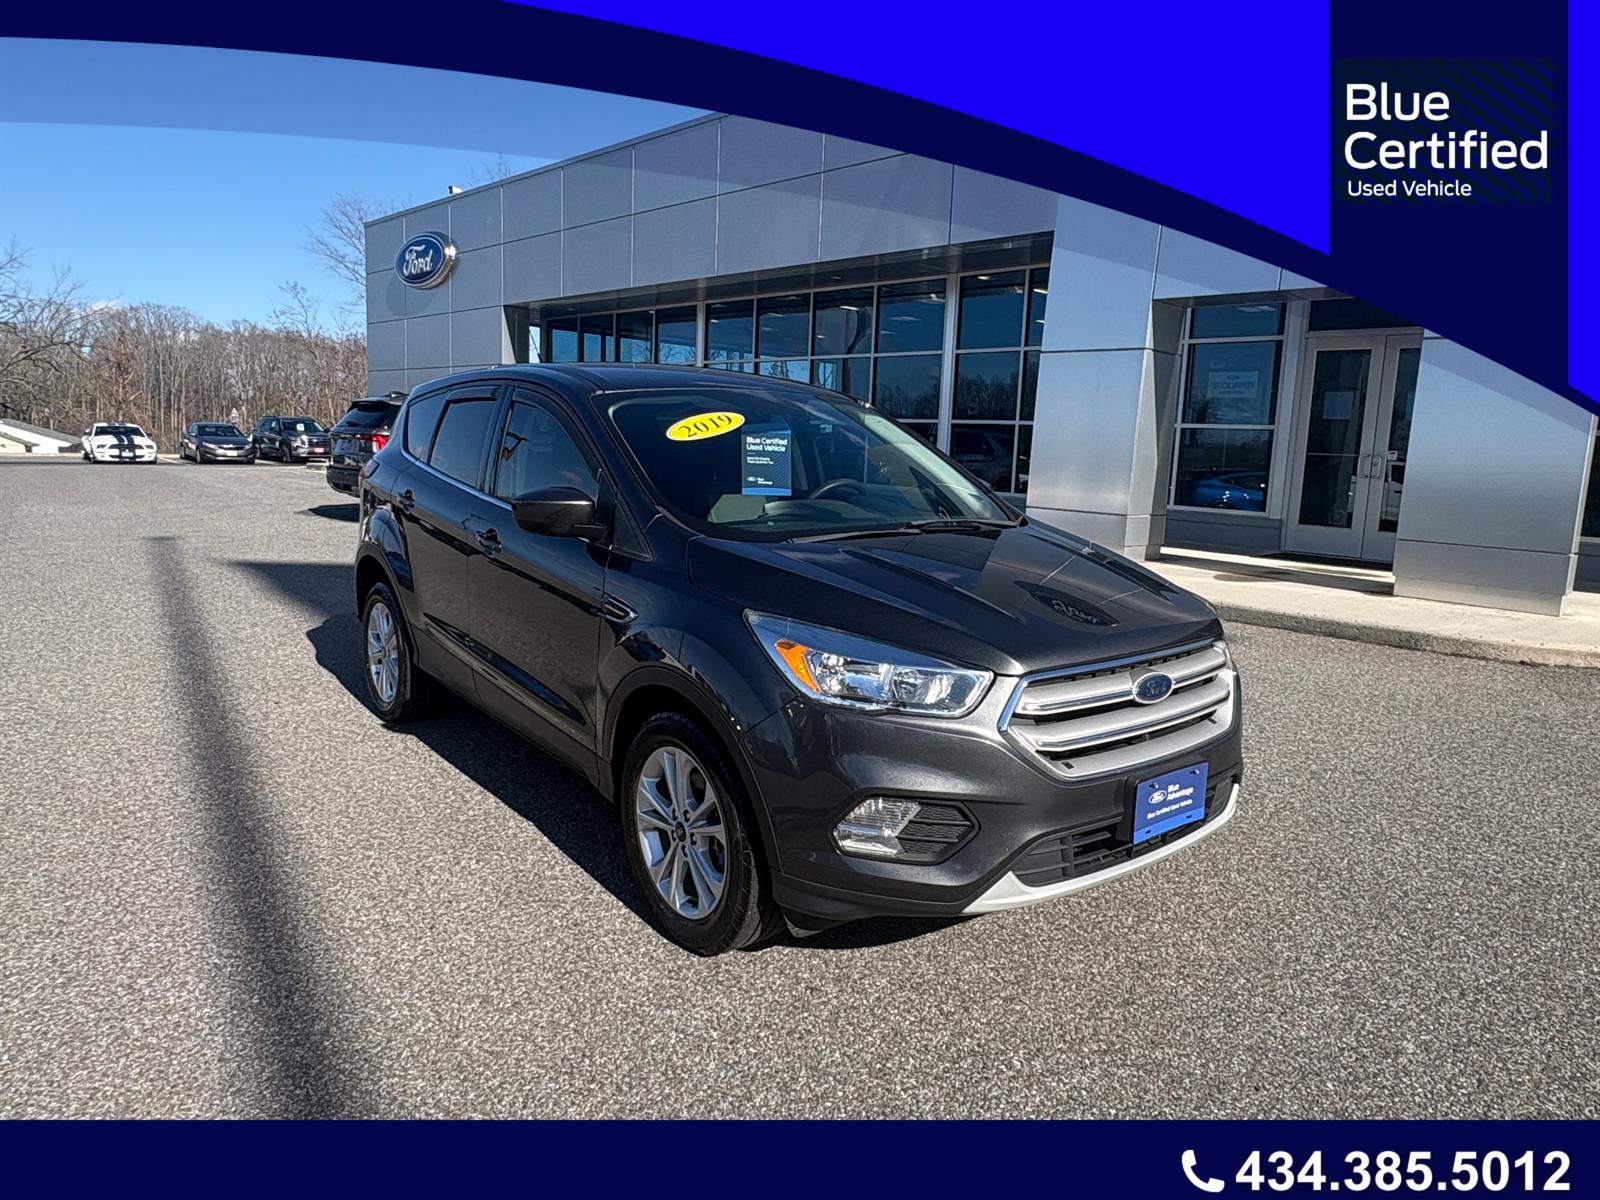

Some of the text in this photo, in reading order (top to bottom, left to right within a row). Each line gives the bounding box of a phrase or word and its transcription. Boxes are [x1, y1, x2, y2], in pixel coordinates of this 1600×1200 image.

[403, 244, 433, 277] Ford
[678, 414, 733, 438] 2019
[746, 436, 788, 446] Blue Certified
[746, 443, 786, 452] Used Vehicle
